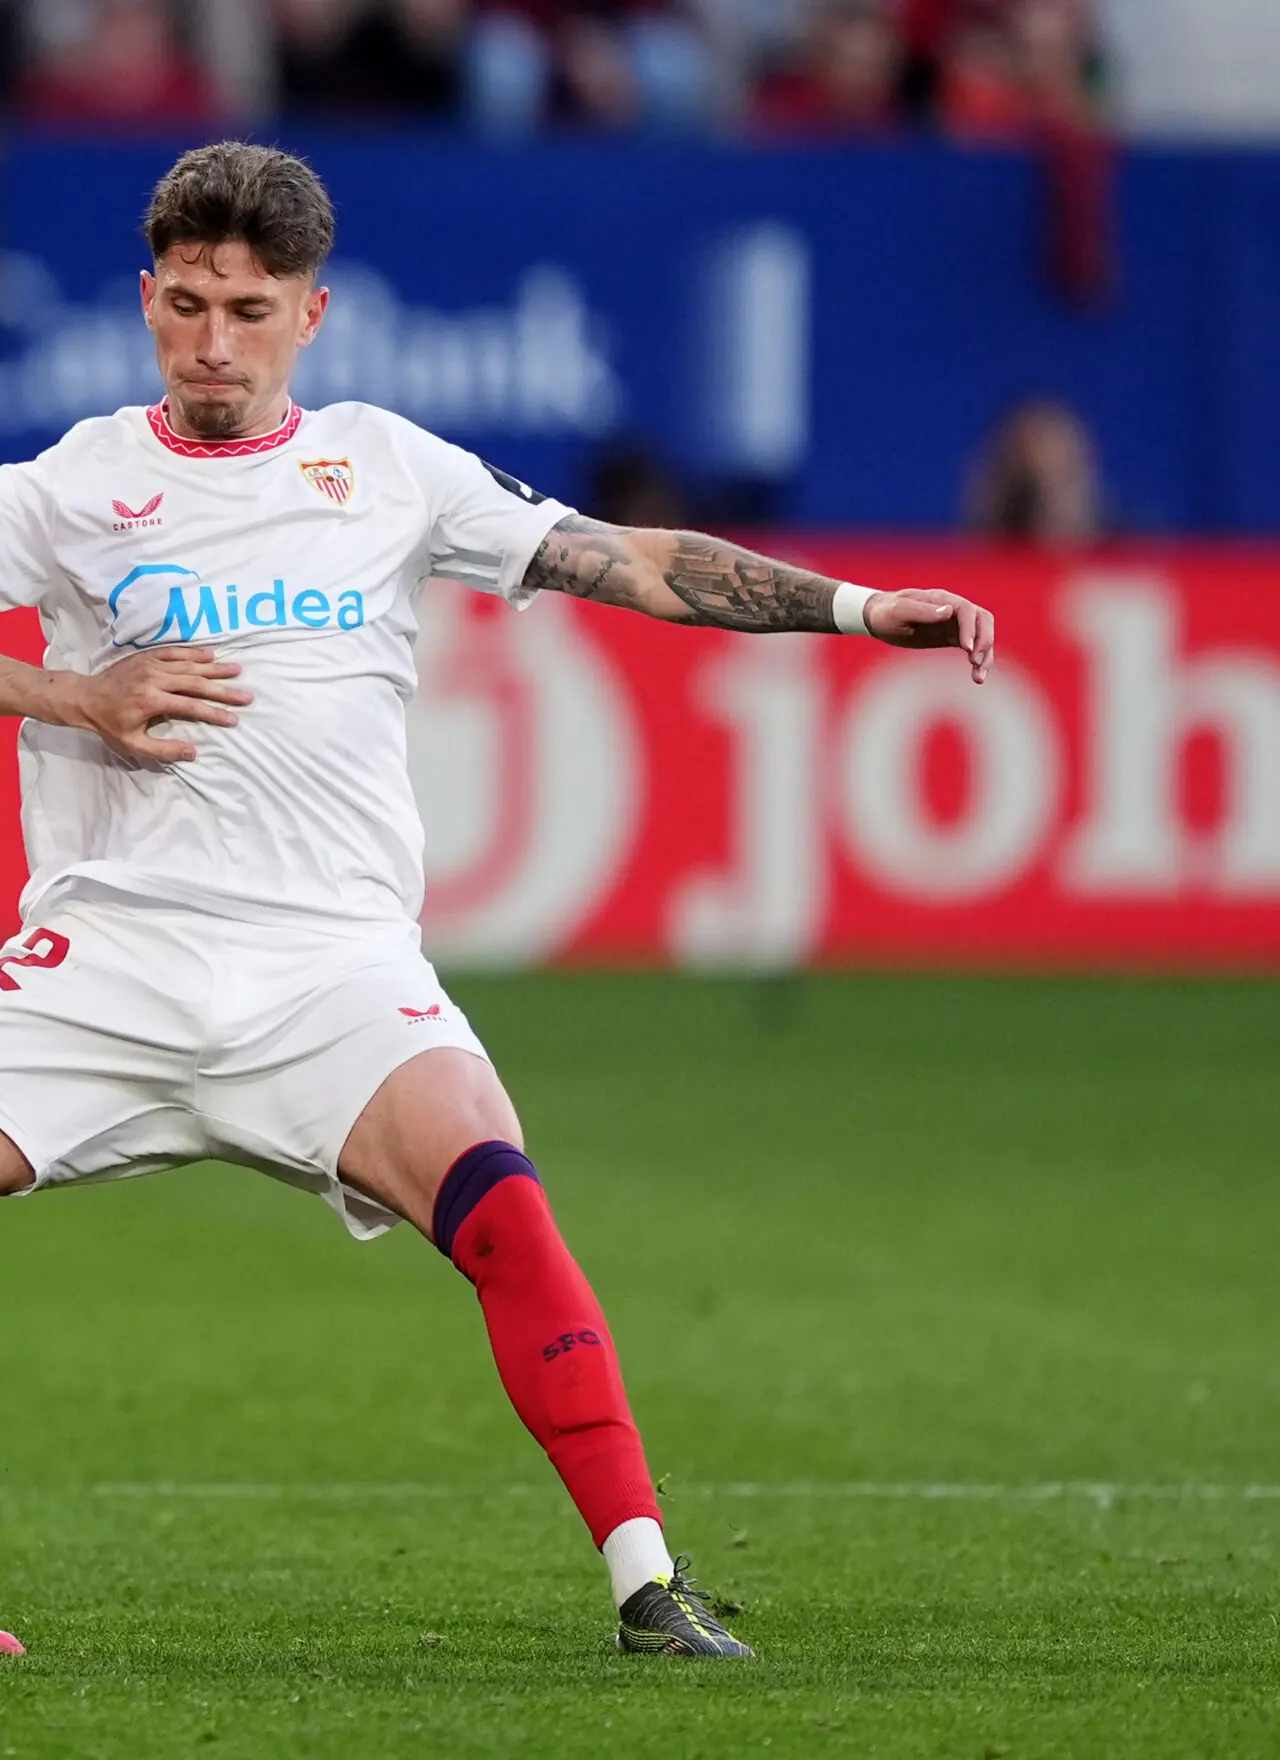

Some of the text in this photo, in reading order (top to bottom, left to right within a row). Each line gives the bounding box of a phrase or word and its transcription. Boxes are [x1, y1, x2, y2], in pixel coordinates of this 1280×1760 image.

[113, 518, 162, 532] CASTORE
[152, 579, 365, 642] Midea
[542, 1330, 601, 1363] SFC
